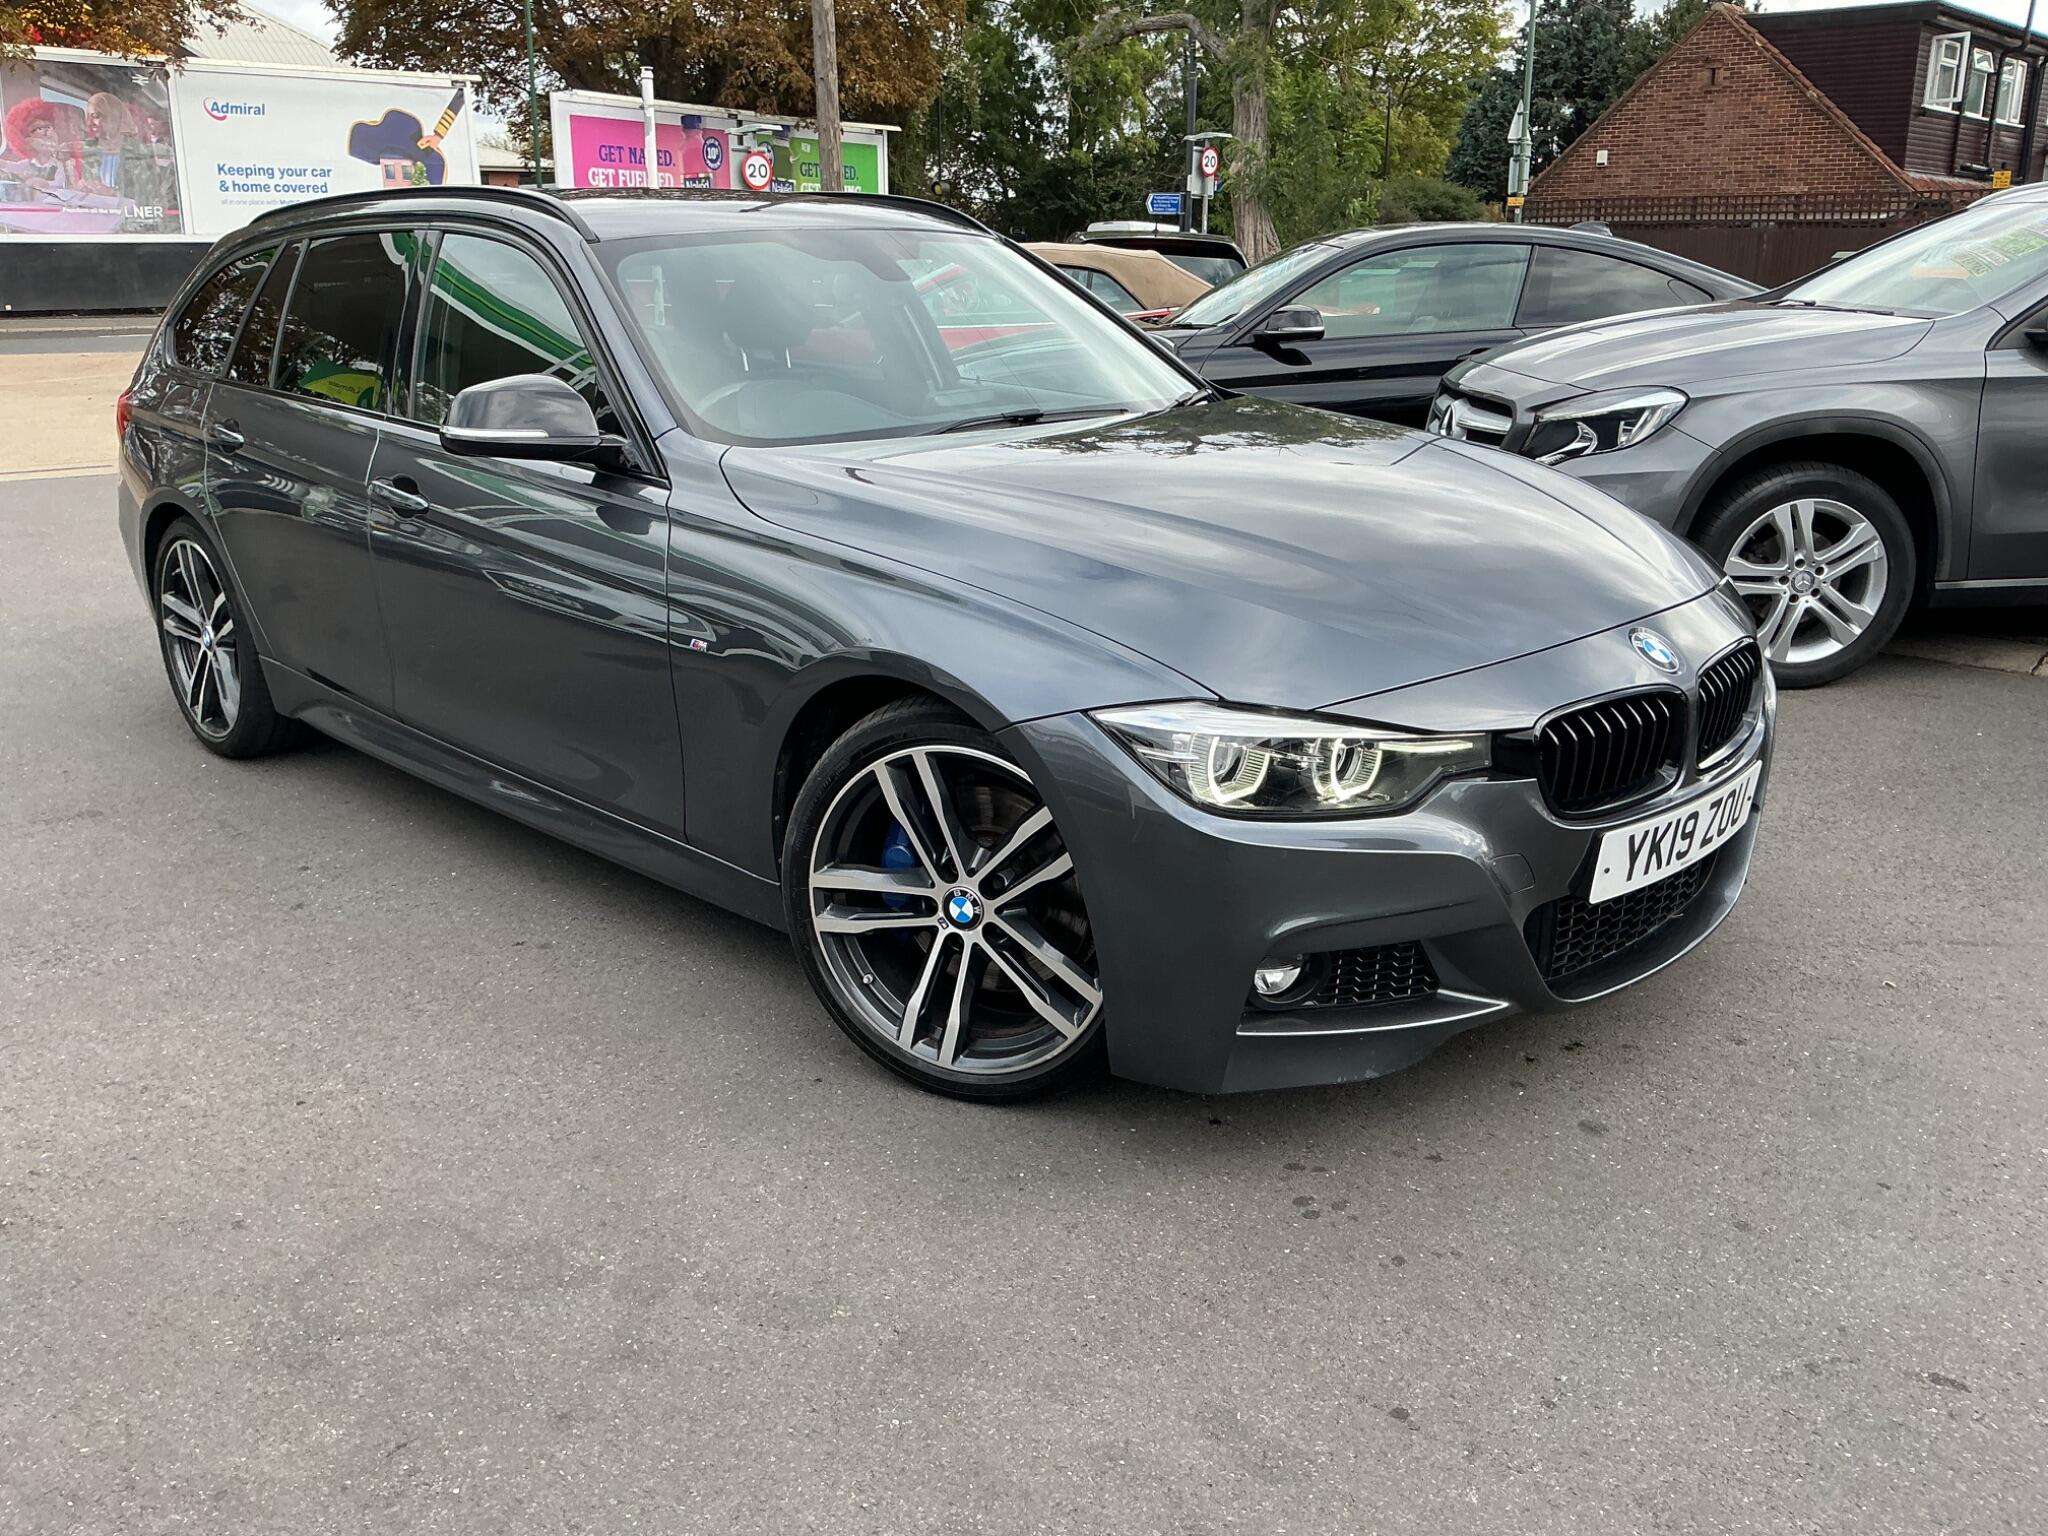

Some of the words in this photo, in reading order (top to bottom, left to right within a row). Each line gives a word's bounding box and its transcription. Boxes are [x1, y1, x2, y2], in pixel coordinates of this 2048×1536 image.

[210, 101, 266, 116] Admiral
[599, 144, 625, 163] GET
[628, 146, 676, 167] NAED.
[1204, 155, 1216, 168] 20
[217, 163, 275, 179] Keeping
[278, 167, 308, 180] your
[310, 168, 332, 178] car
[587, 167, 616, 188] GET
[747, 163, 768, 178] 20
[800, 162, 820, 178] GET
[219, 180, 229, 192] &
[232, 180, 271, 193] home
[274, 182, 329, 194] covered
[124, 205, 164, 219] LNER
[1626, 810, 1700, 882] YK19
[1701, 779, 1750, 850] ZOU
[953, 889, 981, 915] BMW
